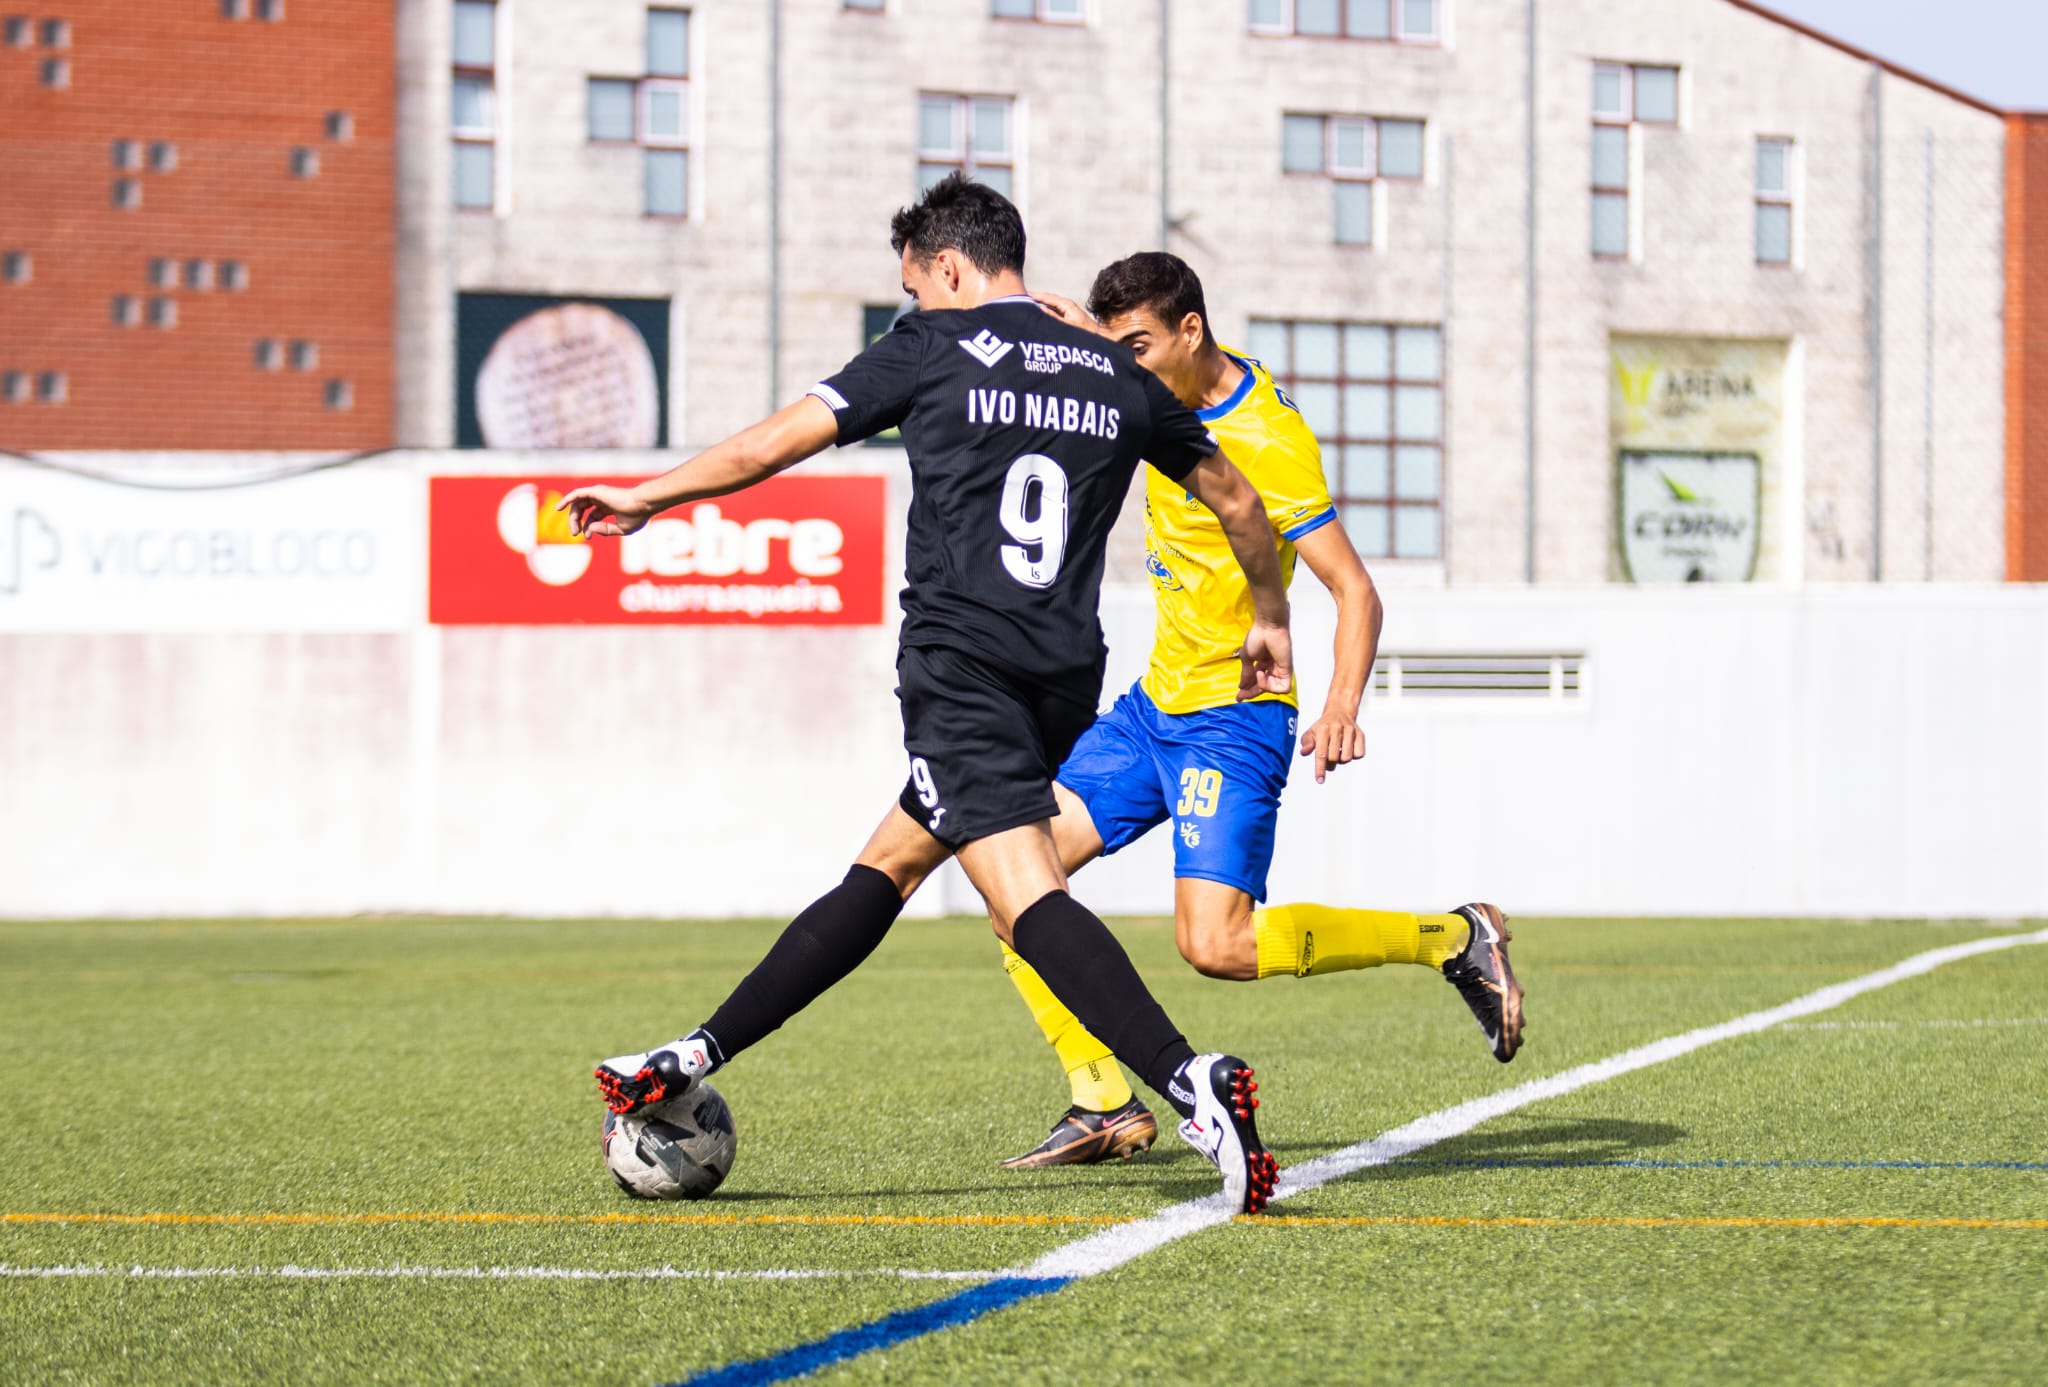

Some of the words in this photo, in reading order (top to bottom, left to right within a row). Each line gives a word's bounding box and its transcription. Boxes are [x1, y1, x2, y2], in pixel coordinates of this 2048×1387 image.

[1019, 341, 1114, 376] VERDASCA
[1025, 360, 1062, 374] GROUP
[968, 389, 1016, 424] IVO
[1025, 393, 1120, 440] NABAIS
[1000, 453, 1068, 589] 9
[912, 758, 939, 808] 9
[1177, 768, 1223, 817] 39
